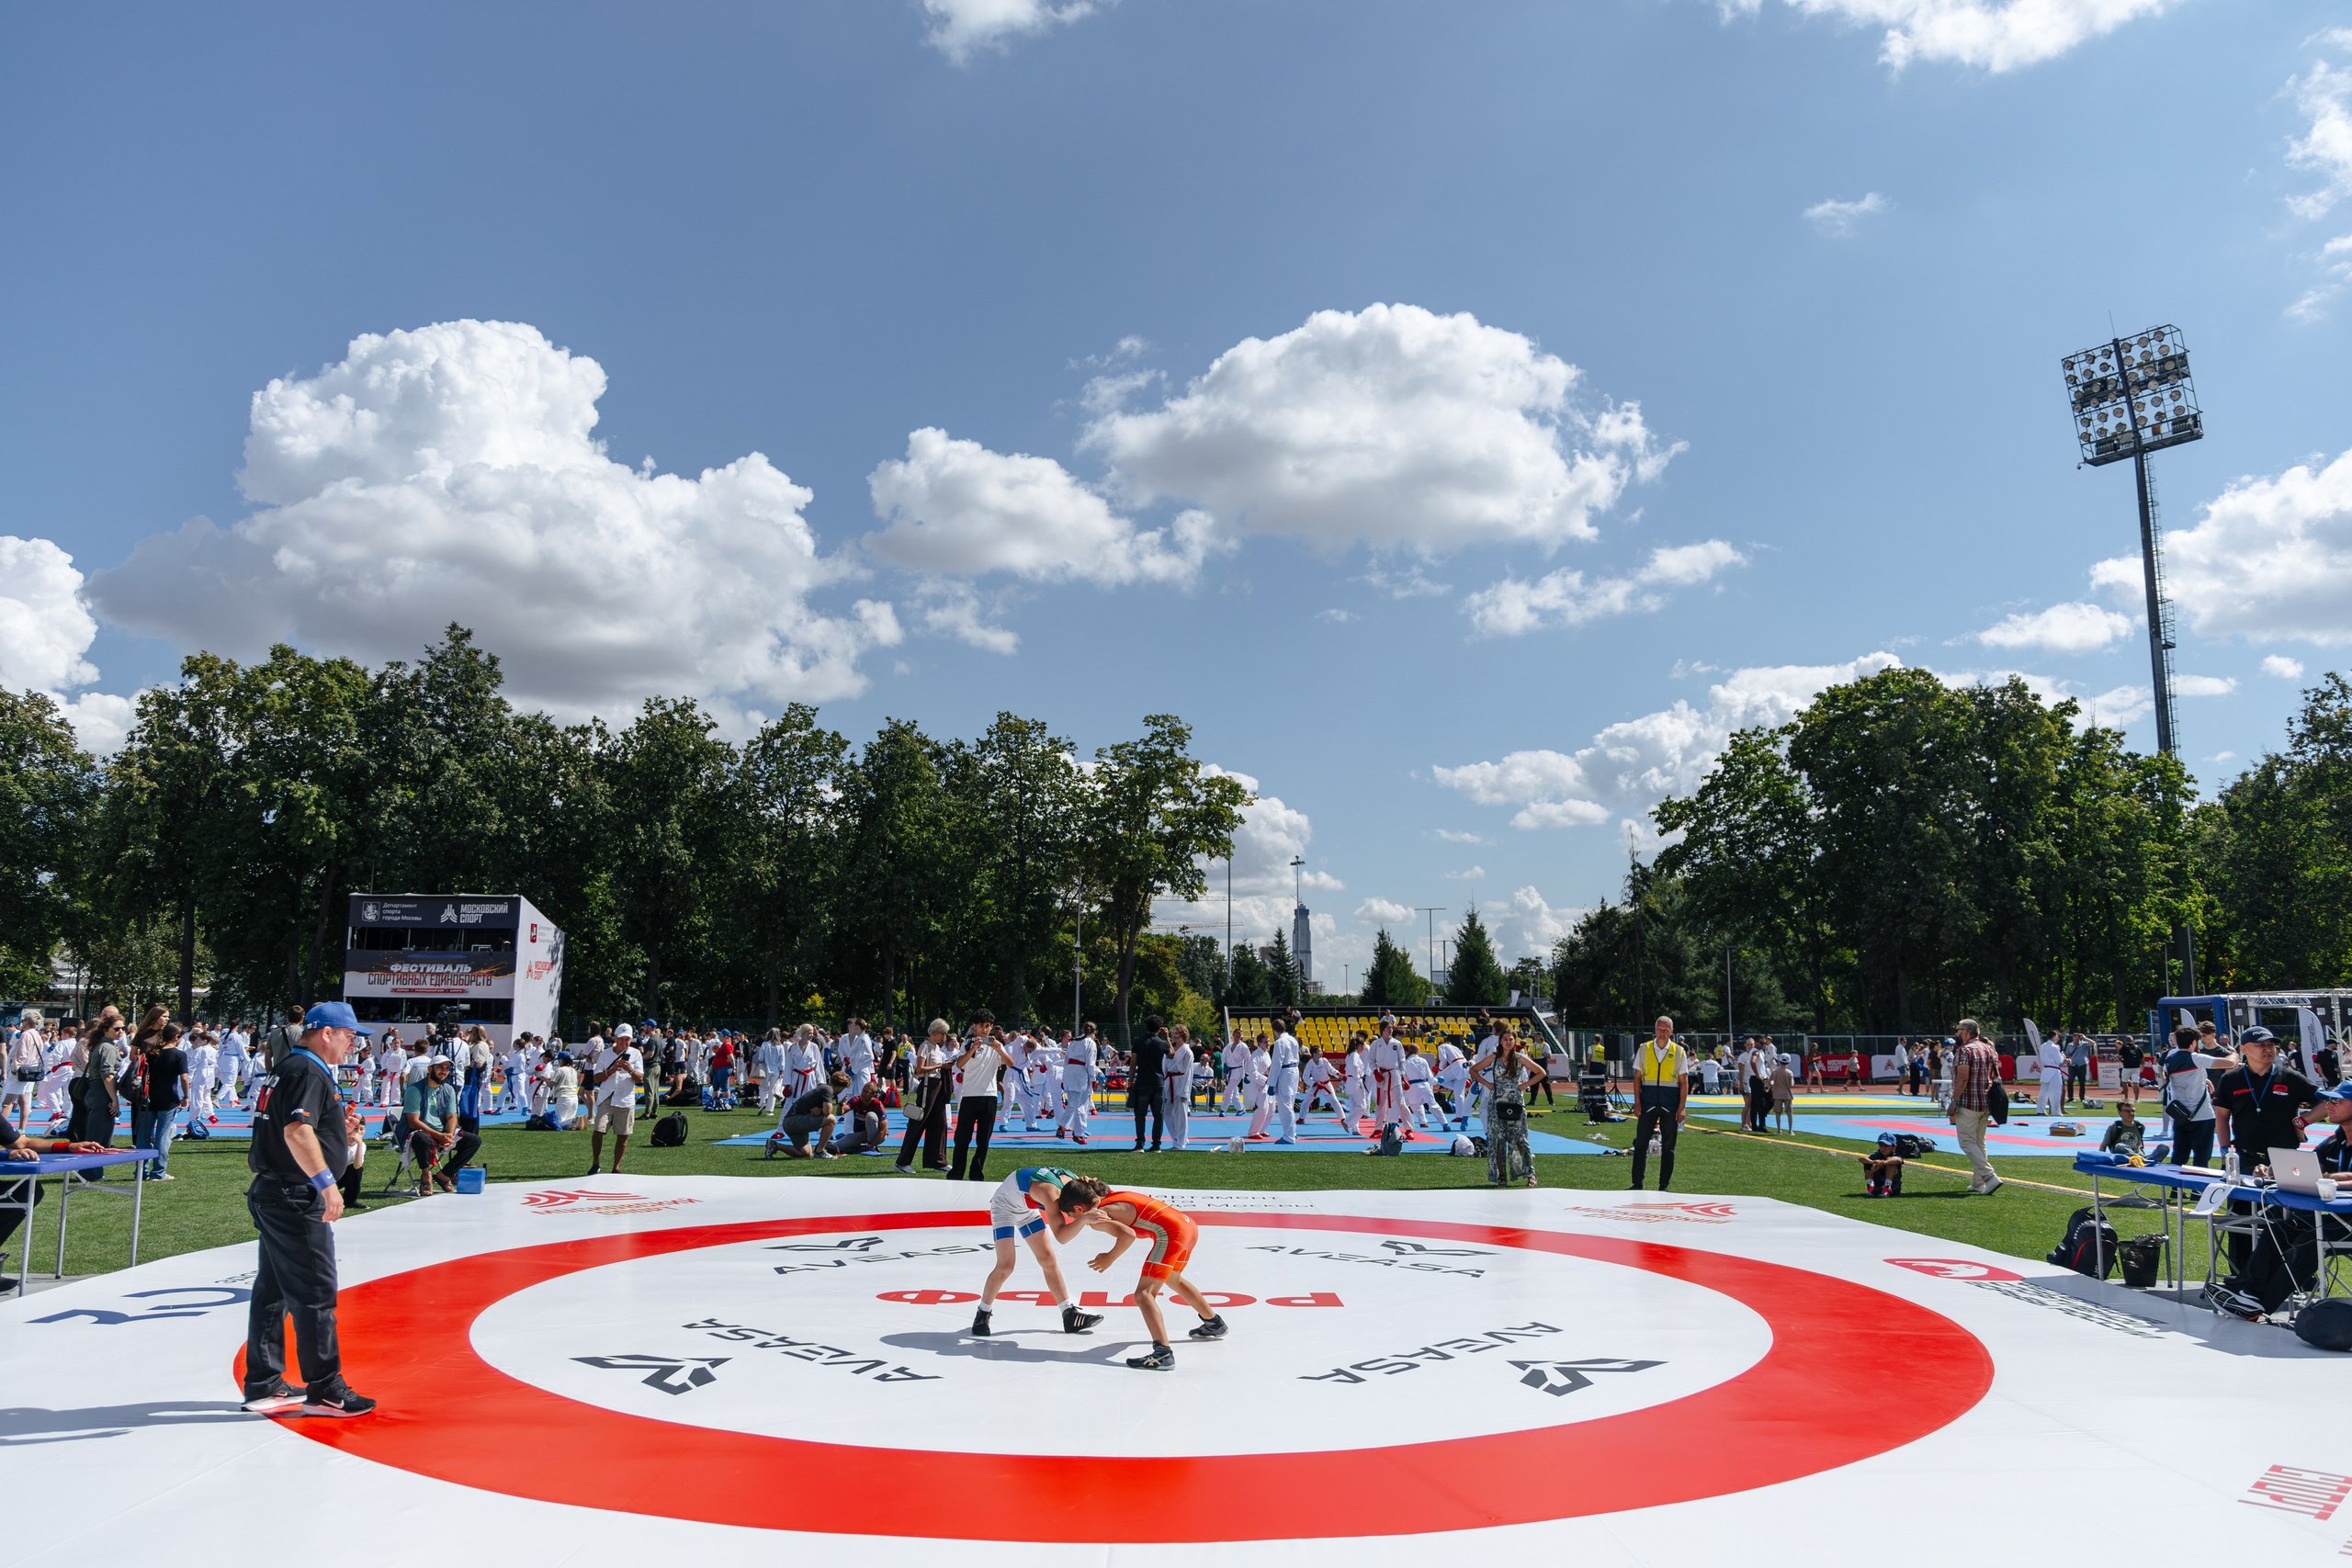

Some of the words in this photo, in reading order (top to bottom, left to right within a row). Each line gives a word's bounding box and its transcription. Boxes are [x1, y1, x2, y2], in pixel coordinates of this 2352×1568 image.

[460, 902, 508, 914] МОСКОВСКИЙ
[459, 914, 483, 923] СПОРТ
[390, 963, 472, 973] ФЕСТИВАЛЬ
[368, 973, 427, 986] СПОРТИВНЫХ
[429, 974, 492, 987] ЕДИНОБОРСТВ
[1243, 1245, 1487, 1279] AVEASA
[876, 1289, 1344, 1307] РОЛЬФ
[681, 1317, 944, 1382] AVEASA
[1295, 1321, 1565, 1384] AVEASA
